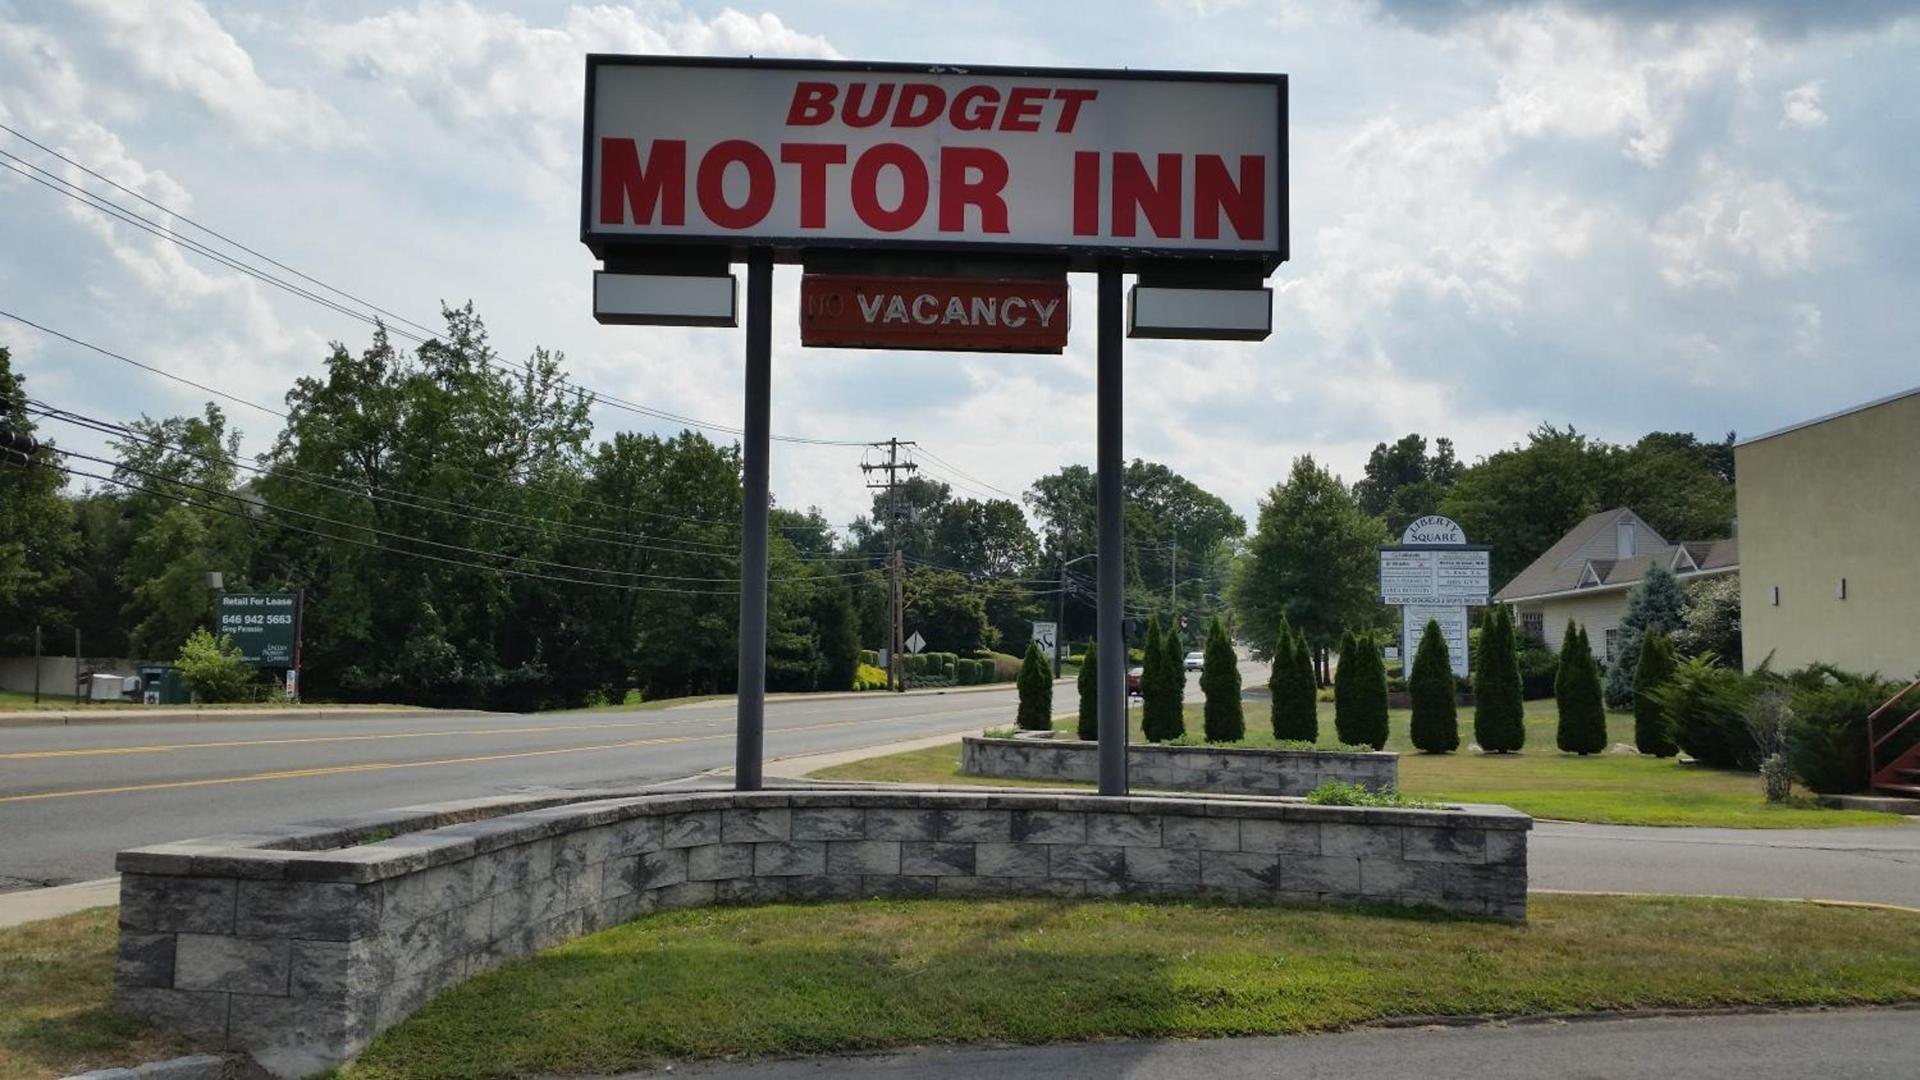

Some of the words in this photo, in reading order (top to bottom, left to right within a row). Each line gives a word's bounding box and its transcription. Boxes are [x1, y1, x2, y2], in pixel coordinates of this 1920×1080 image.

[785, 81, 1098, 134] BUDGET
[600, 136, 1010, 235] MOTOR
[1073, 150, 1266, 242] INN
[808, 293, 844, 318] NO
[857, 293, 1060, 328] VACANCY
[1409, 516, 1459, 533] LIBERTY
[1411, 532, 1457, 543] SQUARE
[222, 597, 248, 605] Retail
[250, 597, 264, 605] For
[266, 597, 293, 606] Lease
[222, 614, 242, 624] 646
[244, 614, 264, 624] 942
[266, 614, 292, 624] 5663
